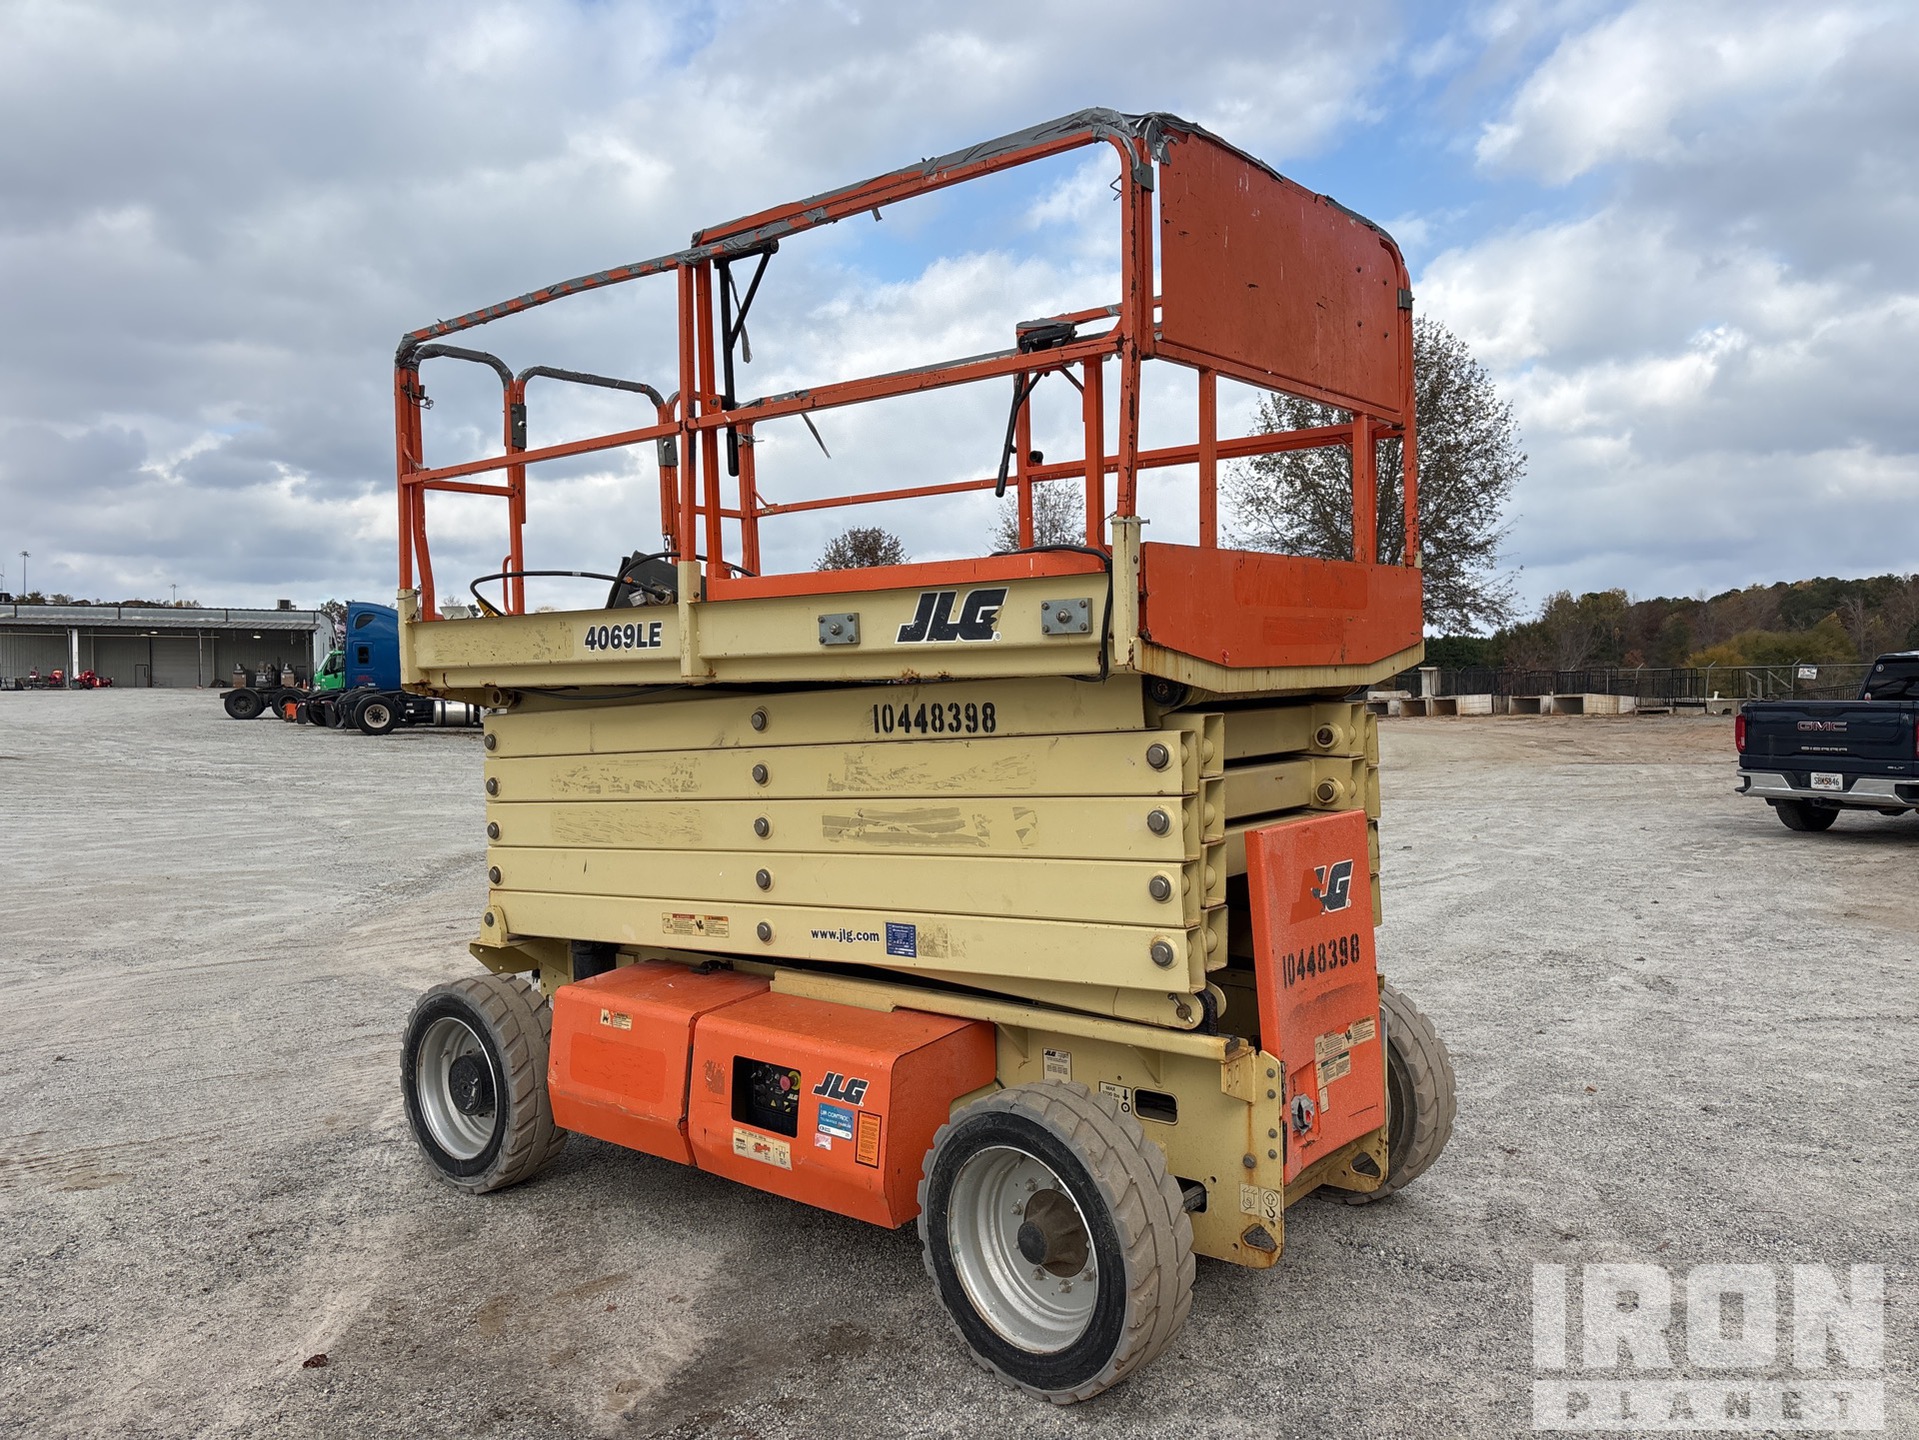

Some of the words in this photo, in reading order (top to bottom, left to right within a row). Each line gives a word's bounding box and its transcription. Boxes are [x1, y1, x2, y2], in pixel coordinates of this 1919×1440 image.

[895, 587, 1009, 643] JLG
[584, 621, 663, 651] 4069LE
[872, 701, 996, 734] 10448398
[1797, 720, 1847, 732] GMC
[810, 928, 880, 943] www.jlg.com
[1282, 933, 1361, 989] 10448398
[812, 1071, 870, 1107] JLG
